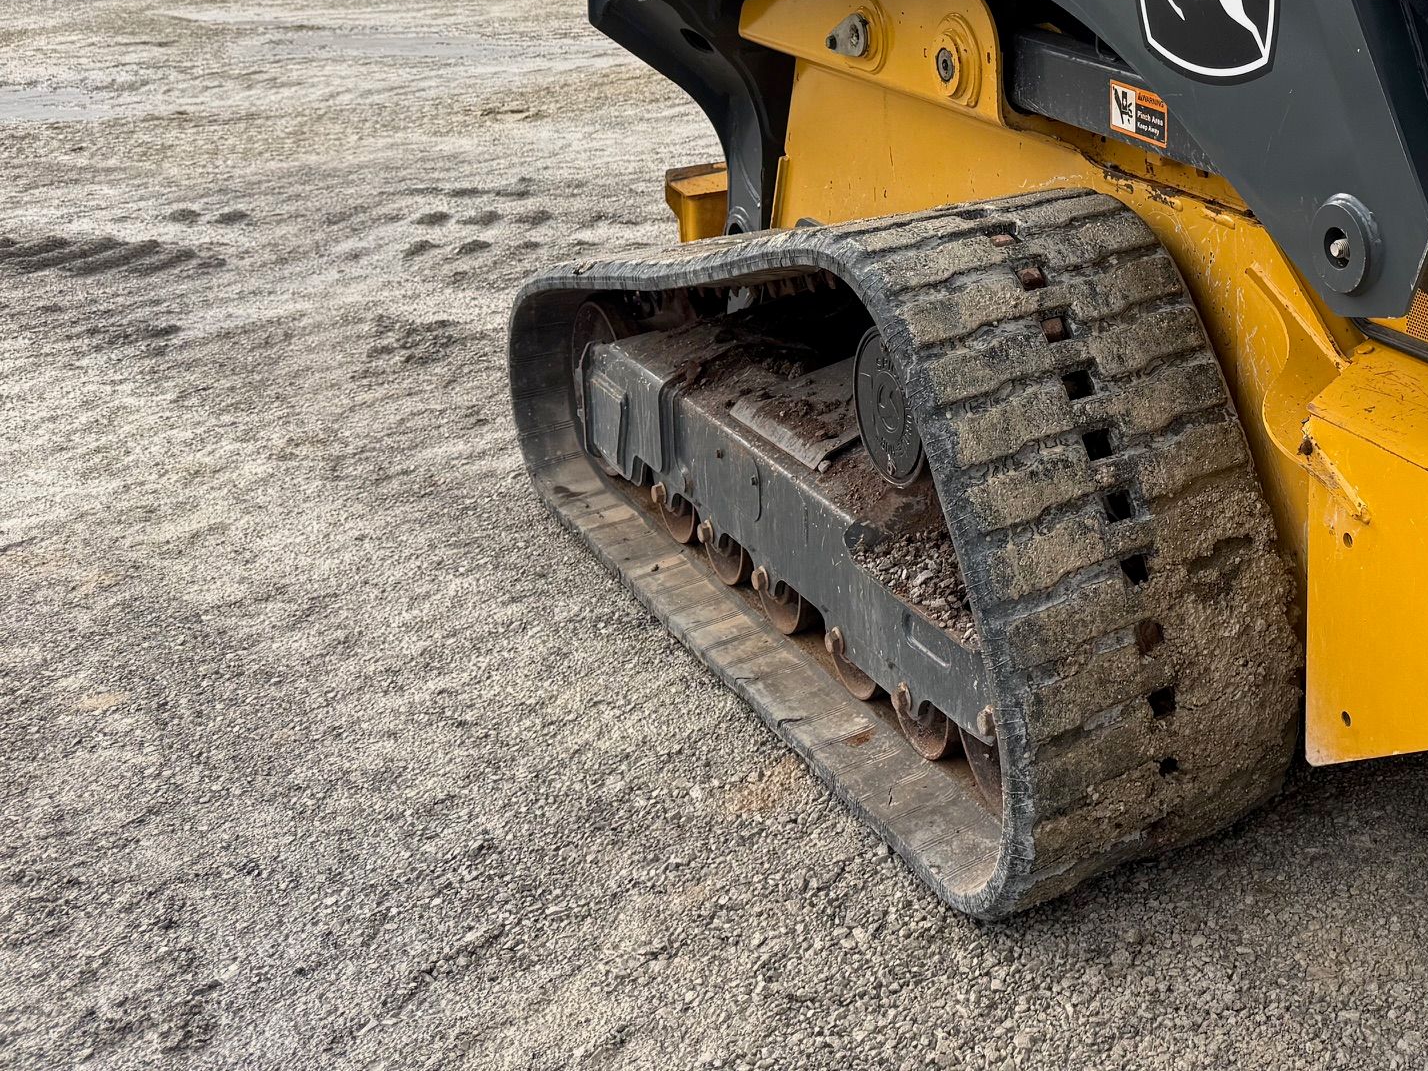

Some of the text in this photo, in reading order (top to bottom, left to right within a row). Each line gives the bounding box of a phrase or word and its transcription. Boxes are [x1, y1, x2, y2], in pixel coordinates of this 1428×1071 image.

[1137, 110, 1164, 127] Pinch Area
[1137, 121, 1160, 136] Keep Away
